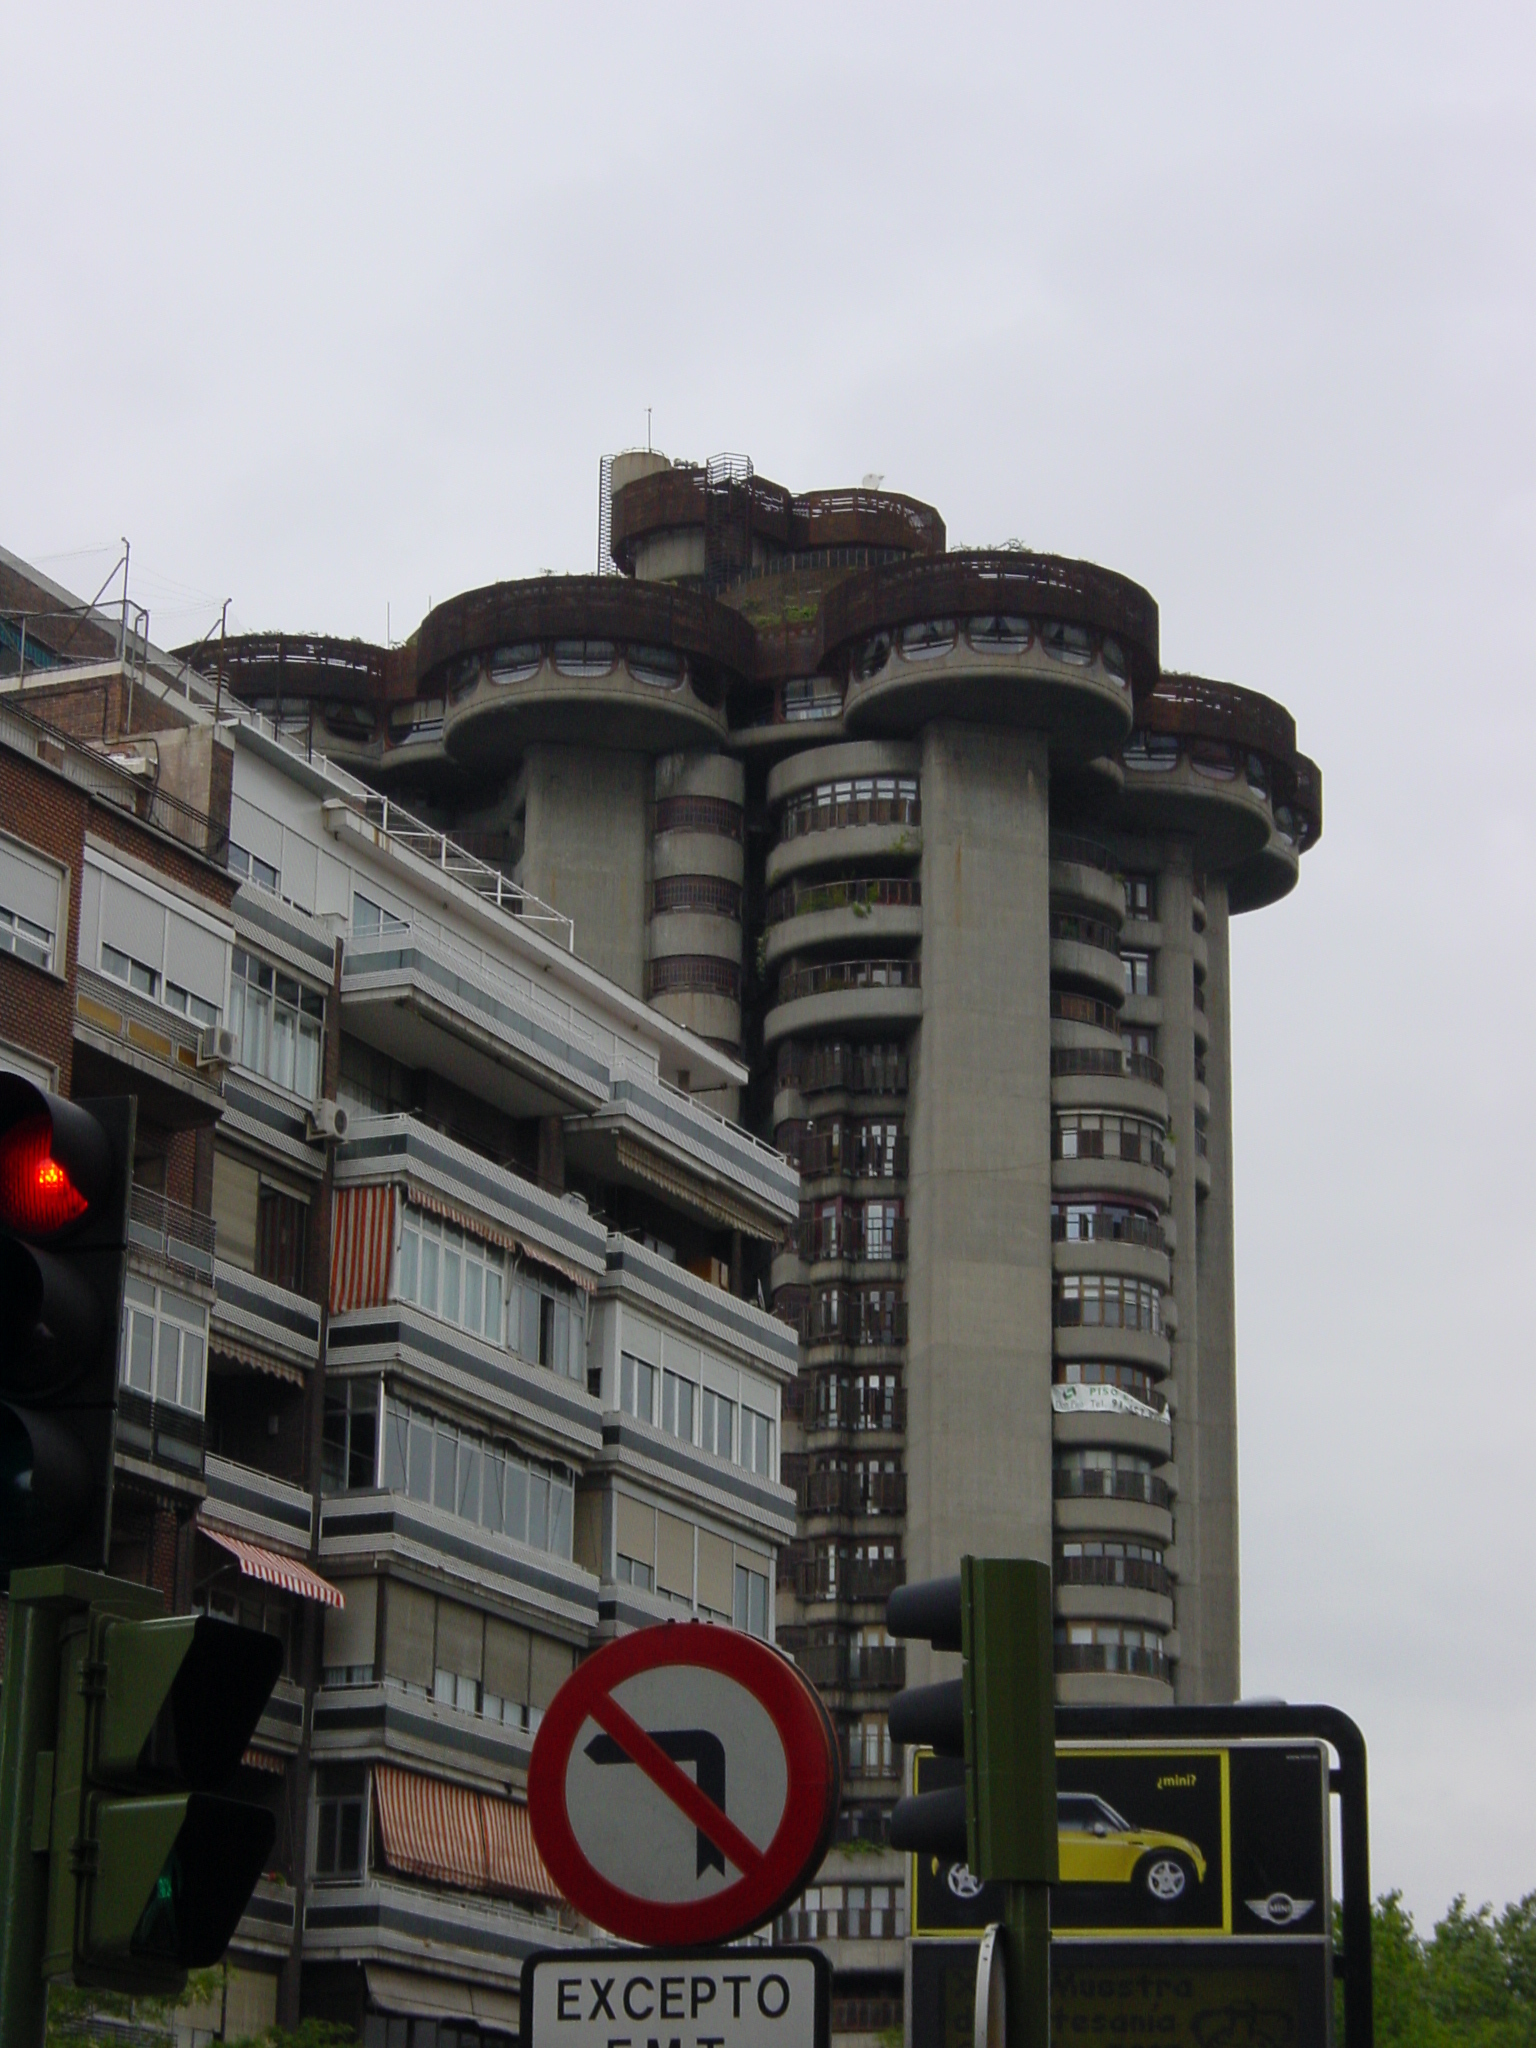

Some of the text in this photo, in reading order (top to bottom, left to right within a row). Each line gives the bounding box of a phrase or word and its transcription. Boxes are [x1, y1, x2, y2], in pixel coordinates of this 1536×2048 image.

[1156, 1773, 1197, 1790] ¿mini?
[1269, 1903, 1291, 1912] MINI
[556, 1973, 791, 2021] EXCEPTO
[1052, 2003, 1176, 2033] tesanía
